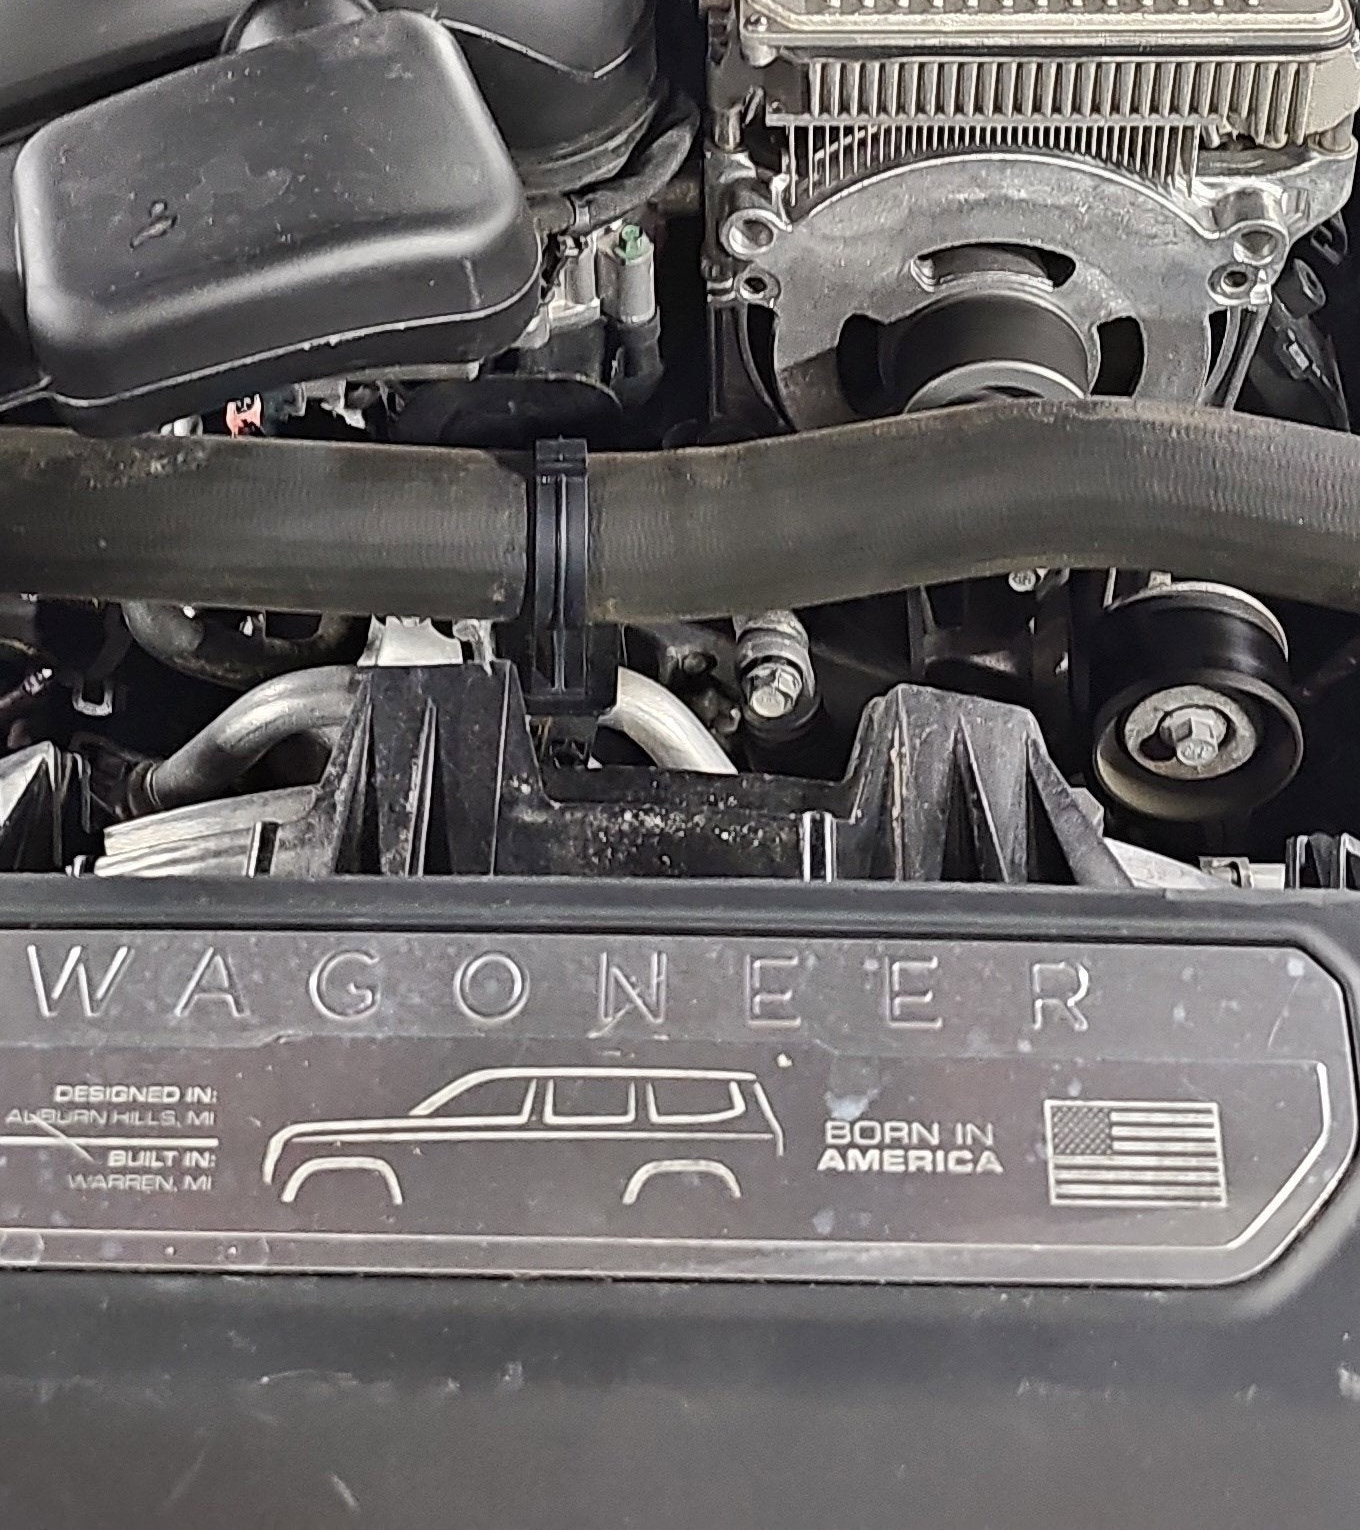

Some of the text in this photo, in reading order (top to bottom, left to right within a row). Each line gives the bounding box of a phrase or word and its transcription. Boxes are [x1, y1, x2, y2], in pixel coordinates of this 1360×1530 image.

[26, 944, 1089, 1031] WAGONEER
[53, 1084, 218, 1104] DESIGNED IN:
[5, 1107, 215, 1129] AUBURN HILLS, MI
[825, 1120, 994, 1147] BORN IN
[107, 1150, 217, 1168] BUILT IN:
[817, 1148, 1005, 1174] AMERICA
[68, 1174, 213, 1193] WARREN, MI
